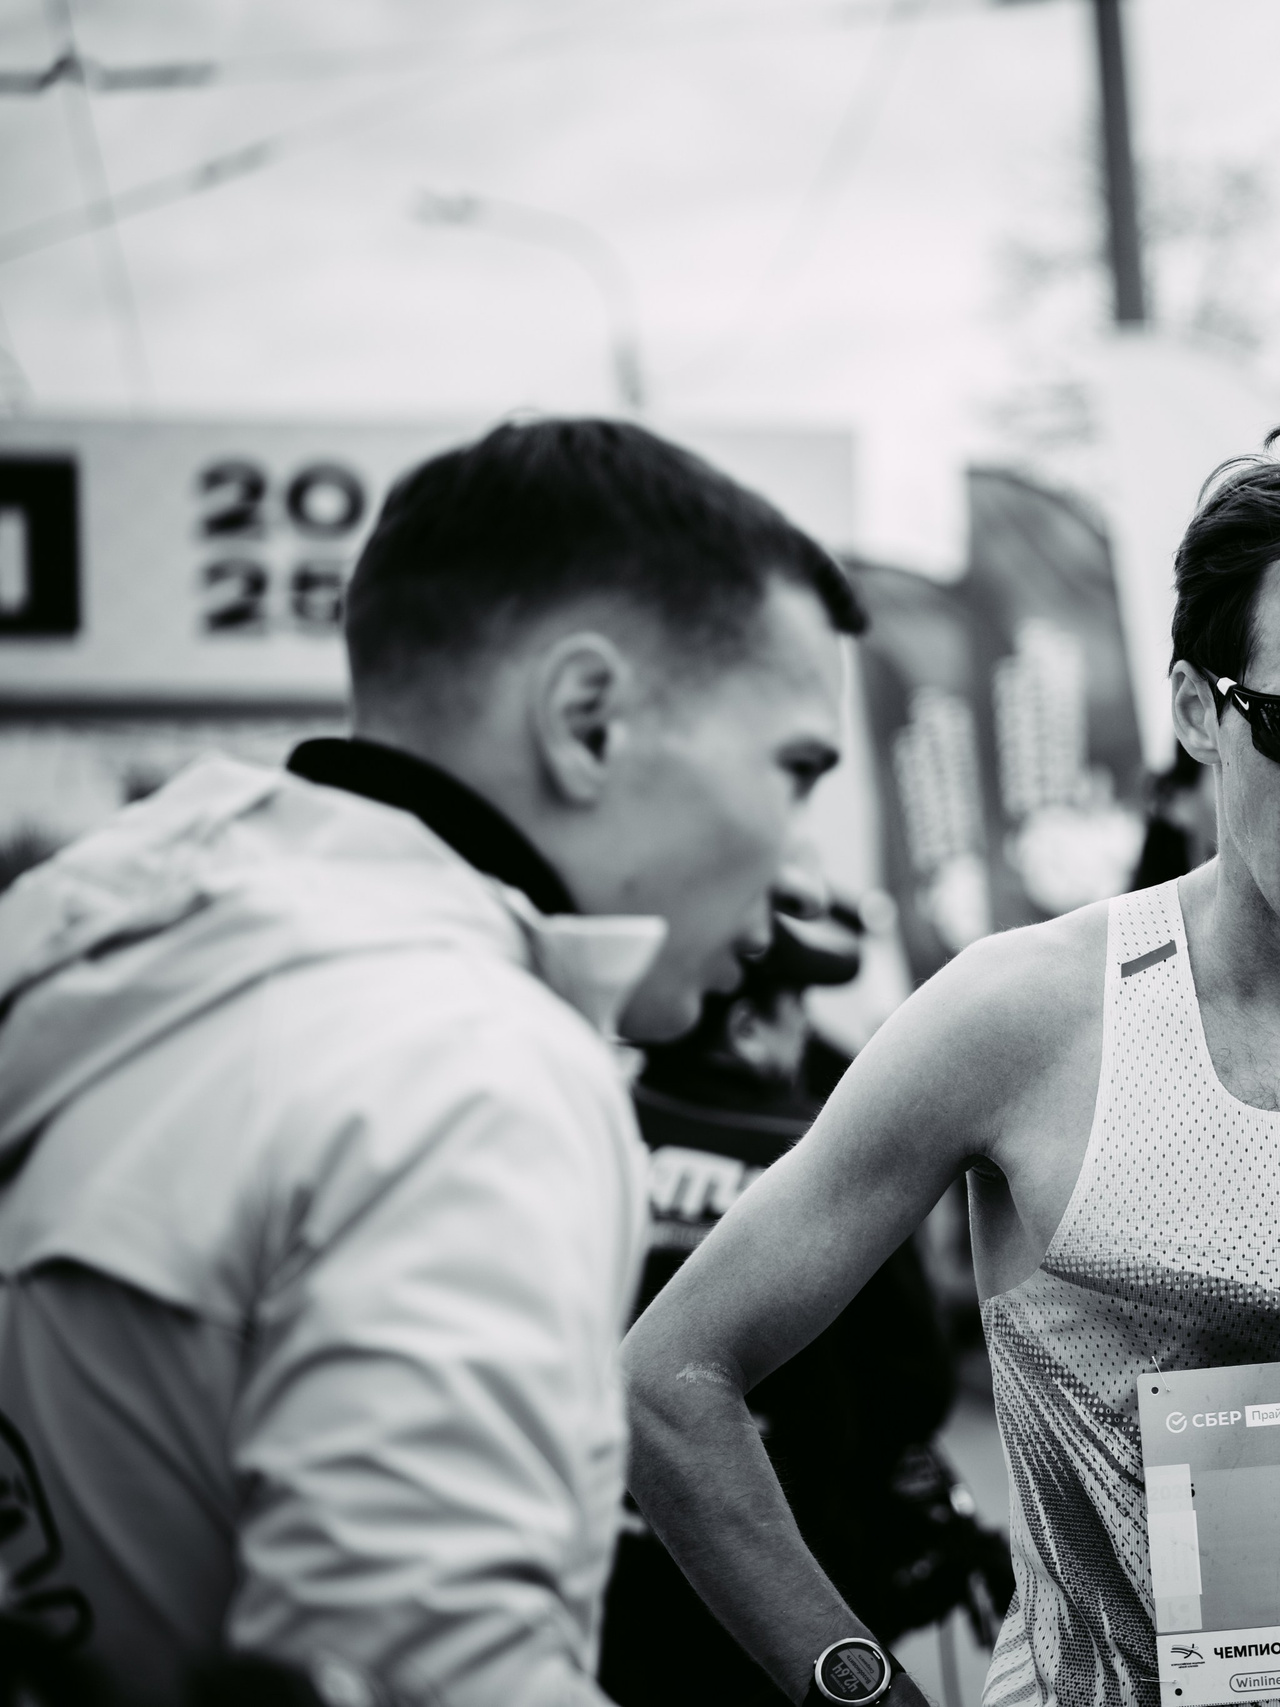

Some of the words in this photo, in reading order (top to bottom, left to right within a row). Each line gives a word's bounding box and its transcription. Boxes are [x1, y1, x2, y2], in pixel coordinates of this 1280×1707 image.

[200, 460, 366, 538] 20
[1191, 1410, 1242, 1428] СБЕР
[832, 1662, 859, 1692] 42.64
[847, 1655, 872, 1684] Возобновить
